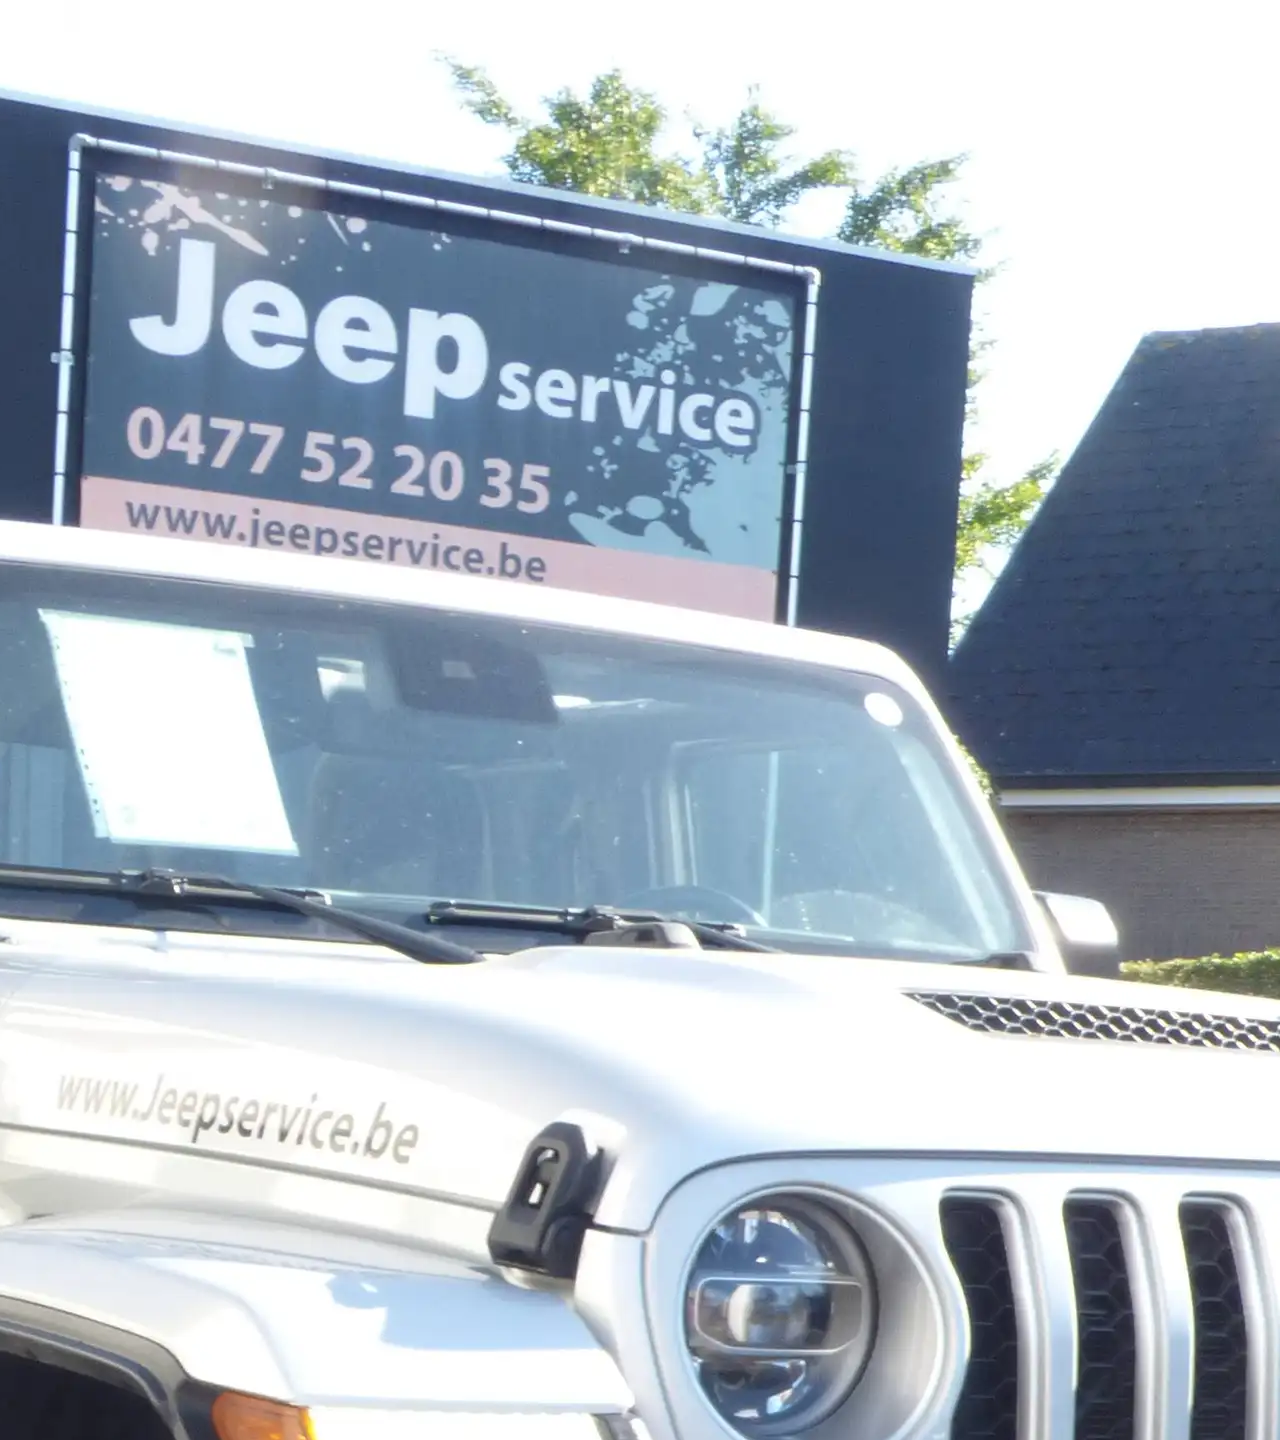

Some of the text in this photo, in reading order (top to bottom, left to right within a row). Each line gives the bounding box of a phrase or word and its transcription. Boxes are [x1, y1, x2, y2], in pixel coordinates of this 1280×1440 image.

[128, 238, 758, 448] Jeep service
[126, 406, 551, 514] 0477 52 20 35
[125, 499, 547, 584] www.jeepservice.be
[55, 1073, 421, 1165] www.Jeepservice.be
